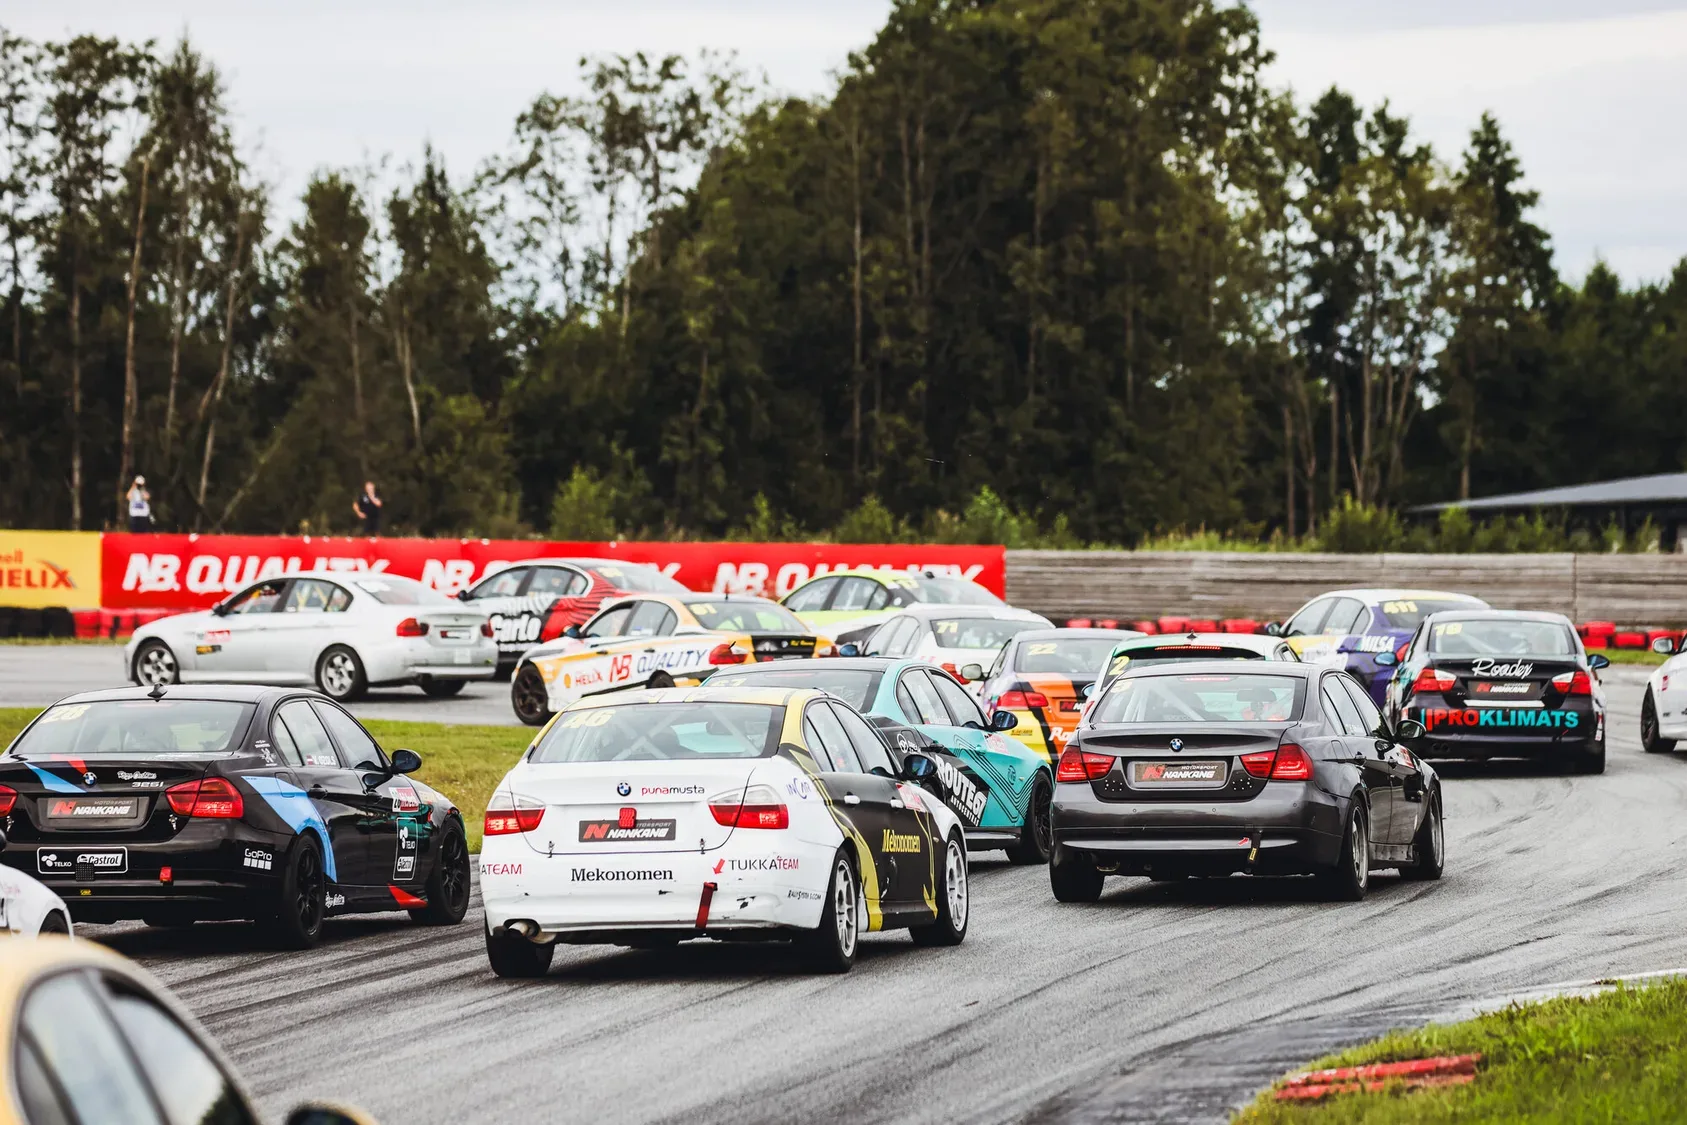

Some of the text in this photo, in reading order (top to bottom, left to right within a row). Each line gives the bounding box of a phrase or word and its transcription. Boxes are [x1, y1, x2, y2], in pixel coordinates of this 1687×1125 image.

[122, 553, 181, 593] NB
[609, 654, 633, 683] NB
[637, 649, 708, 674] QUALITY
[1163, 770, 1215, 779] NANKANG
[641, 785, 705, 796] punamusta
[74, 806, 131, 815] NANKANG
[607, 828, 669, 839] NANKANG
[882, 829, 921, 853] Mekonomen
[88, 855, 119, 866] Castrol
[244, 848, 272, 861] GoPro
[729, 856, 799, 871] TUKKATEAM
[571, 868, 674, 882] Mekonomen
